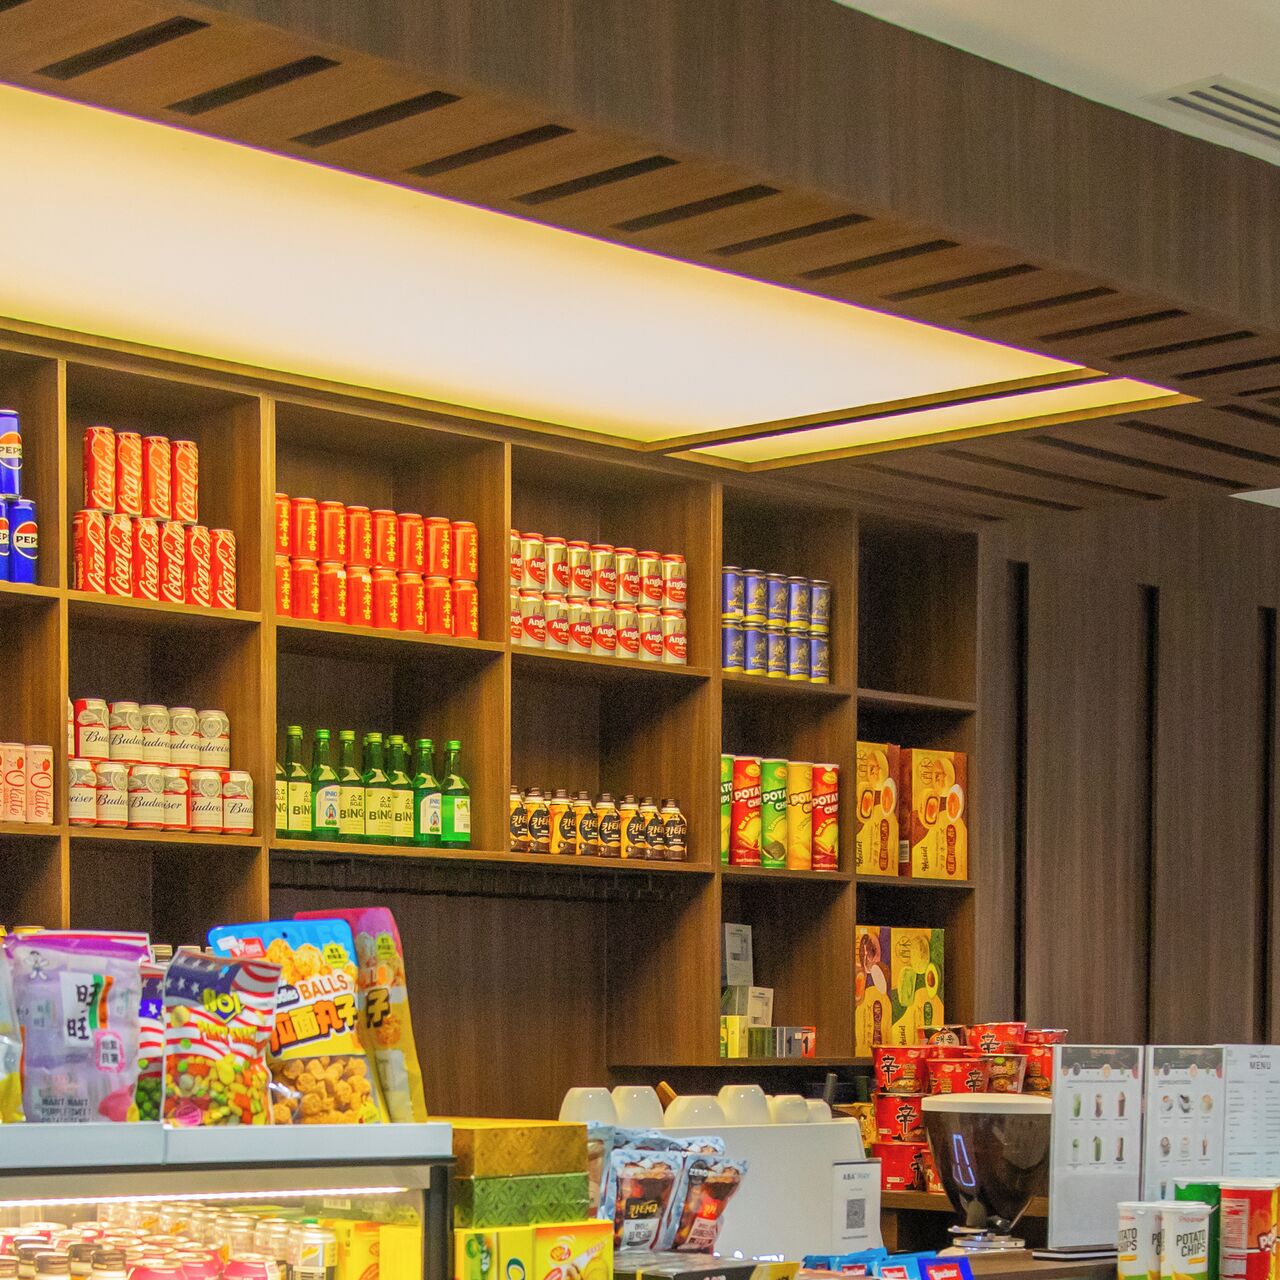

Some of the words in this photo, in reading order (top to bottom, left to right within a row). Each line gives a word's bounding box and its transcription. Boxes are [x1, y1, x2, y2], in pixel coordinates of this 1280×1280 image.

[299, 975, 348, 1000] BALLS
[881, 1056, 899, 1085] 辛
[1249, 1061, 1272, 1070] MENU
[896, 1104, 918, 1134] 辛
[1176, 1228, 1206, 1246] POTATO
[1181, 1243, 1206, 1258] CHIPS
